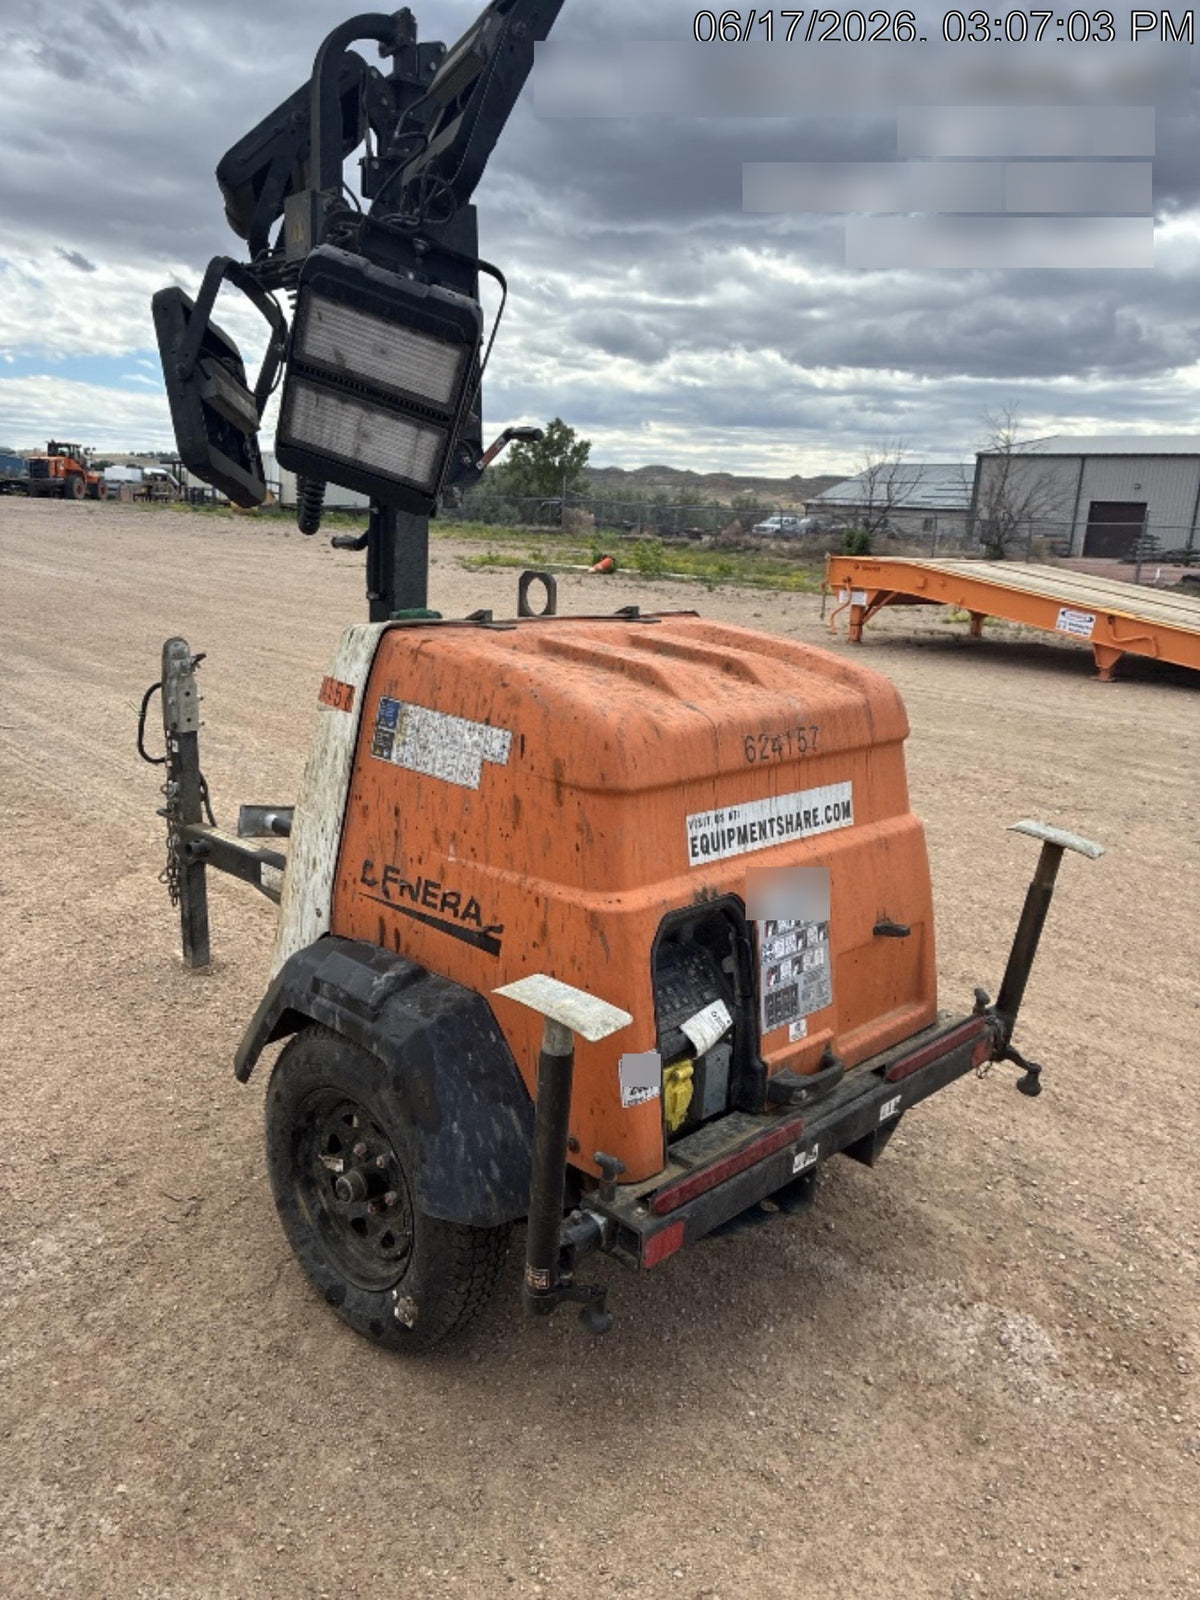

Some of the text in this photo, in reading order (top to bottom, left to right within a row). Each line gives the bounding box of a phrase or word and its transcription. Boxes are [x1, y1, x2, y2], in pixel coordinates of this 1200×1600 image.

[744, 725, 818, 763] 624157
[688, 816, 711, 830] VISIT
[690, 800, 851, 858] EQUIPMENTSHARE.COM
